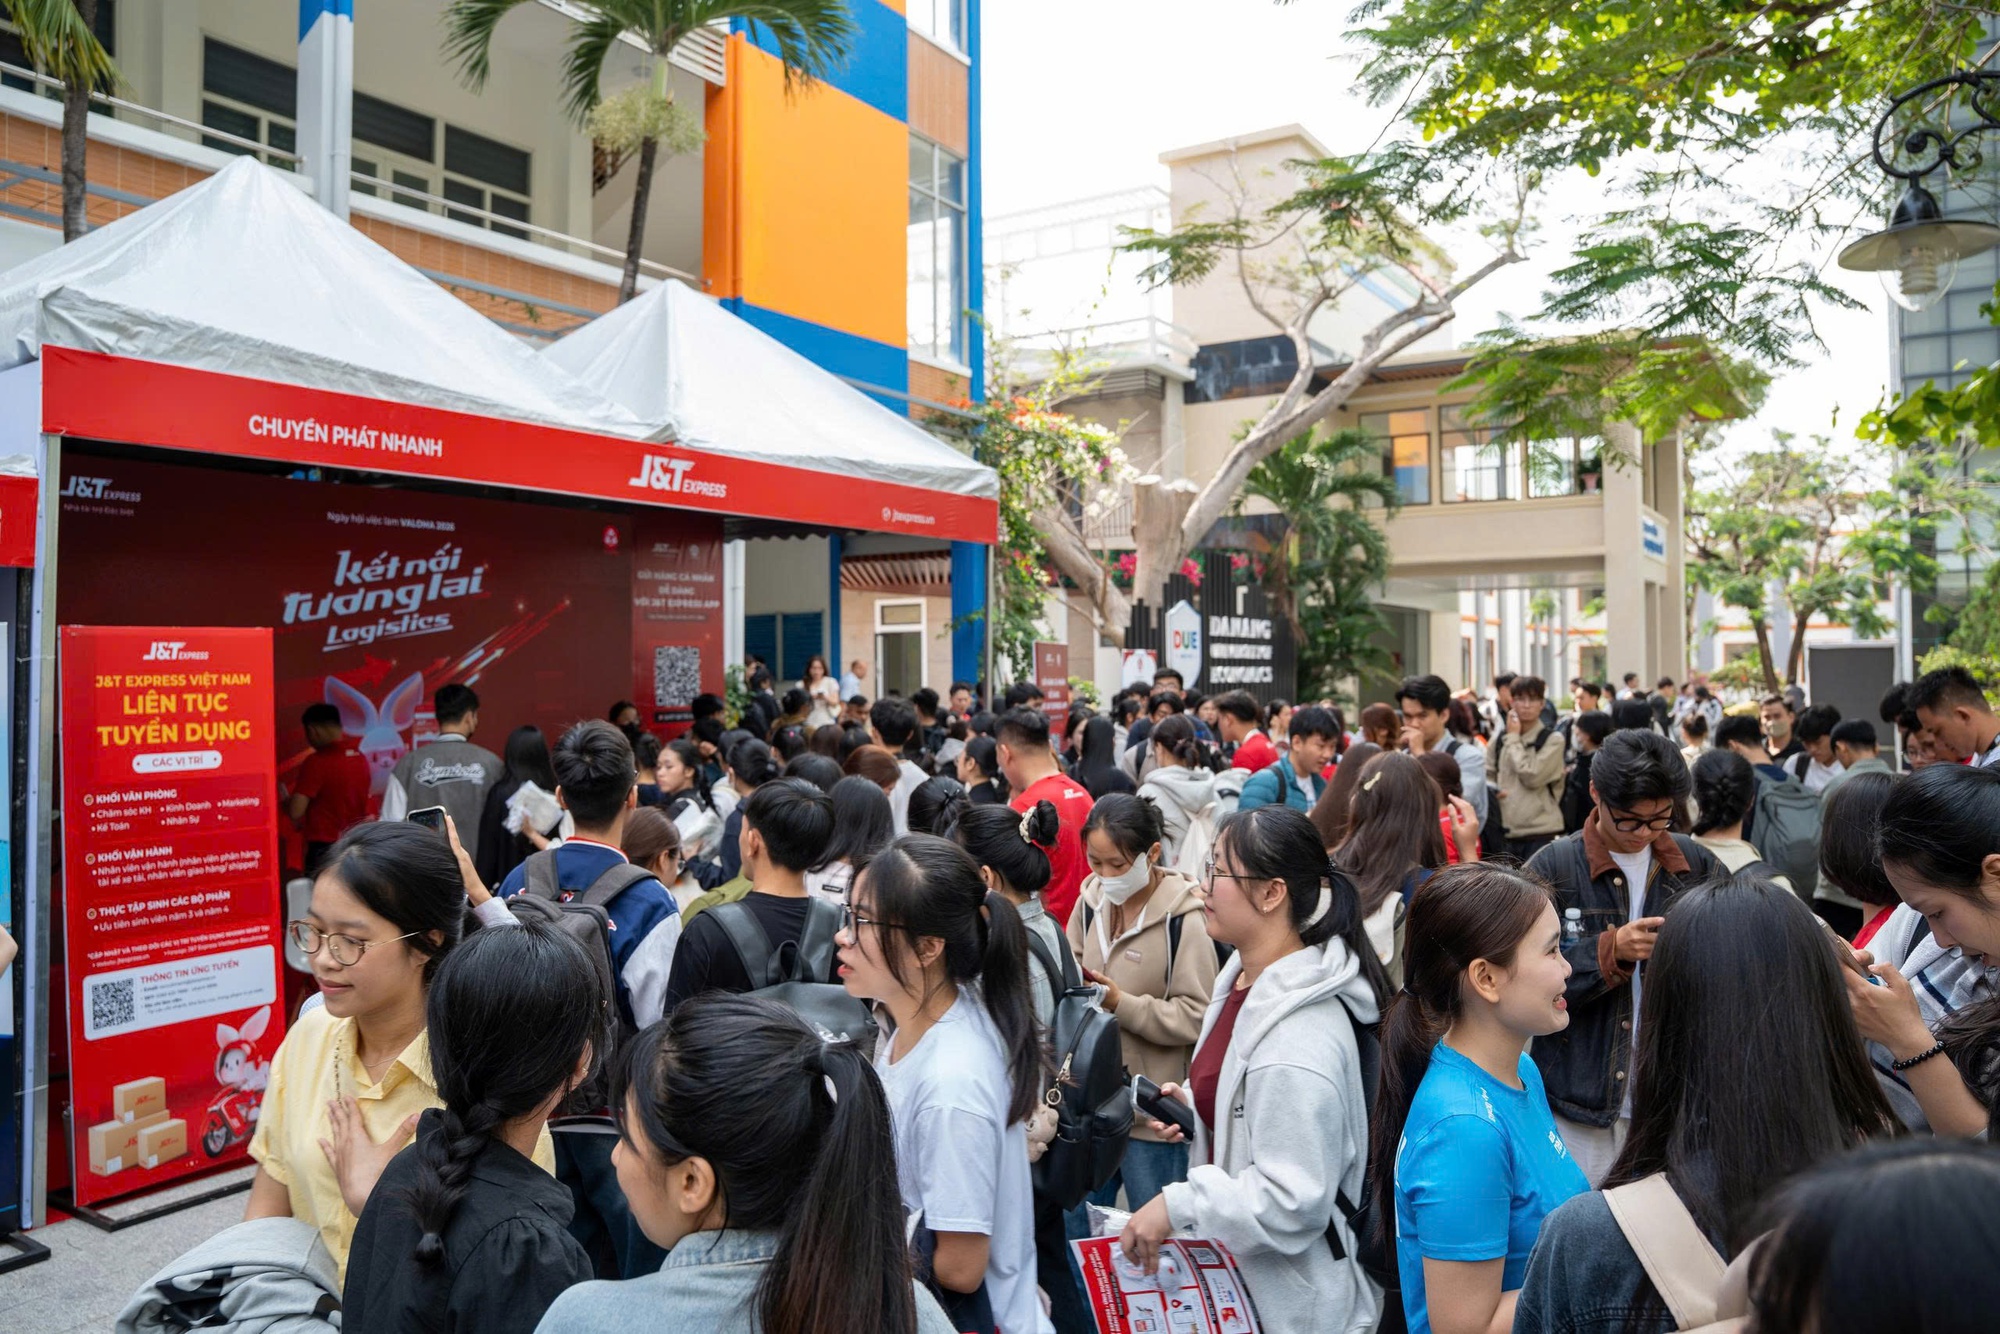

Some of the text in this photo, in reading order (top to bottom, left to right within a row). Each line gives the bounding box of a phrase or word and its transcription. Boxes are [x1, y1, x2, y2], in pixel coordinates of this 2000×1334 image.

[332, 425, 379, 449] PHÁT
[382, 431, 443, 457] NHANH
[629, 454, 727, 498] J&T EXPRESS
[60, 475, 142, 502] J&T EXPRESS
[403, 542, 462, 577] nối
[427, 566, 484, 601] lai
[326, 613, 451, 645] Logistics
[1173, 630, 1197, 650] DUE
[143, 642, 209, 660] J&T EXPRESS
[96, 671, 251, 688] J&T EXPRESS VIỆT NAM
[123, 689, 228, 717] LIÊN TỤC
[97, 717, 251, 747] TUYỂN DỤNG
[152, 753, 203, 768] CÁC VỊ TRÍ
[96, 788, 178, 804] KHỐI VĂN PHÒNG
[222, 797, 260, 809] Marketing
[96, 806, 152, 819] Chăm sóc KH
[166, 801, 212, 813] Kinh Doanh
[97, 821, 130, 832] Kế Toán
[166, 815, 188, 826] Nhân
[98, 846, 173, 863] KHỐI VẬN HÀNH
[98, 865, 121, 876] Nhân
[99, 890, 231, 918] THỰC TẬP SINH CÁC BỘ PHẬN
[131, 916, 149, 928] sinh
[151, 914, 168, 925] viên
[169, 911, 187, 922] năm
[188, 910, 194, 919] 3
[195, 909, 204, 918] và
[205, 906, 222, 917] năm
[223, 905, 229, 914] 4
[141, 971, 172, 984] THÔNG
[175, 967, 189, 979] TIN
[191, 963, 210, 976] ỨNG
